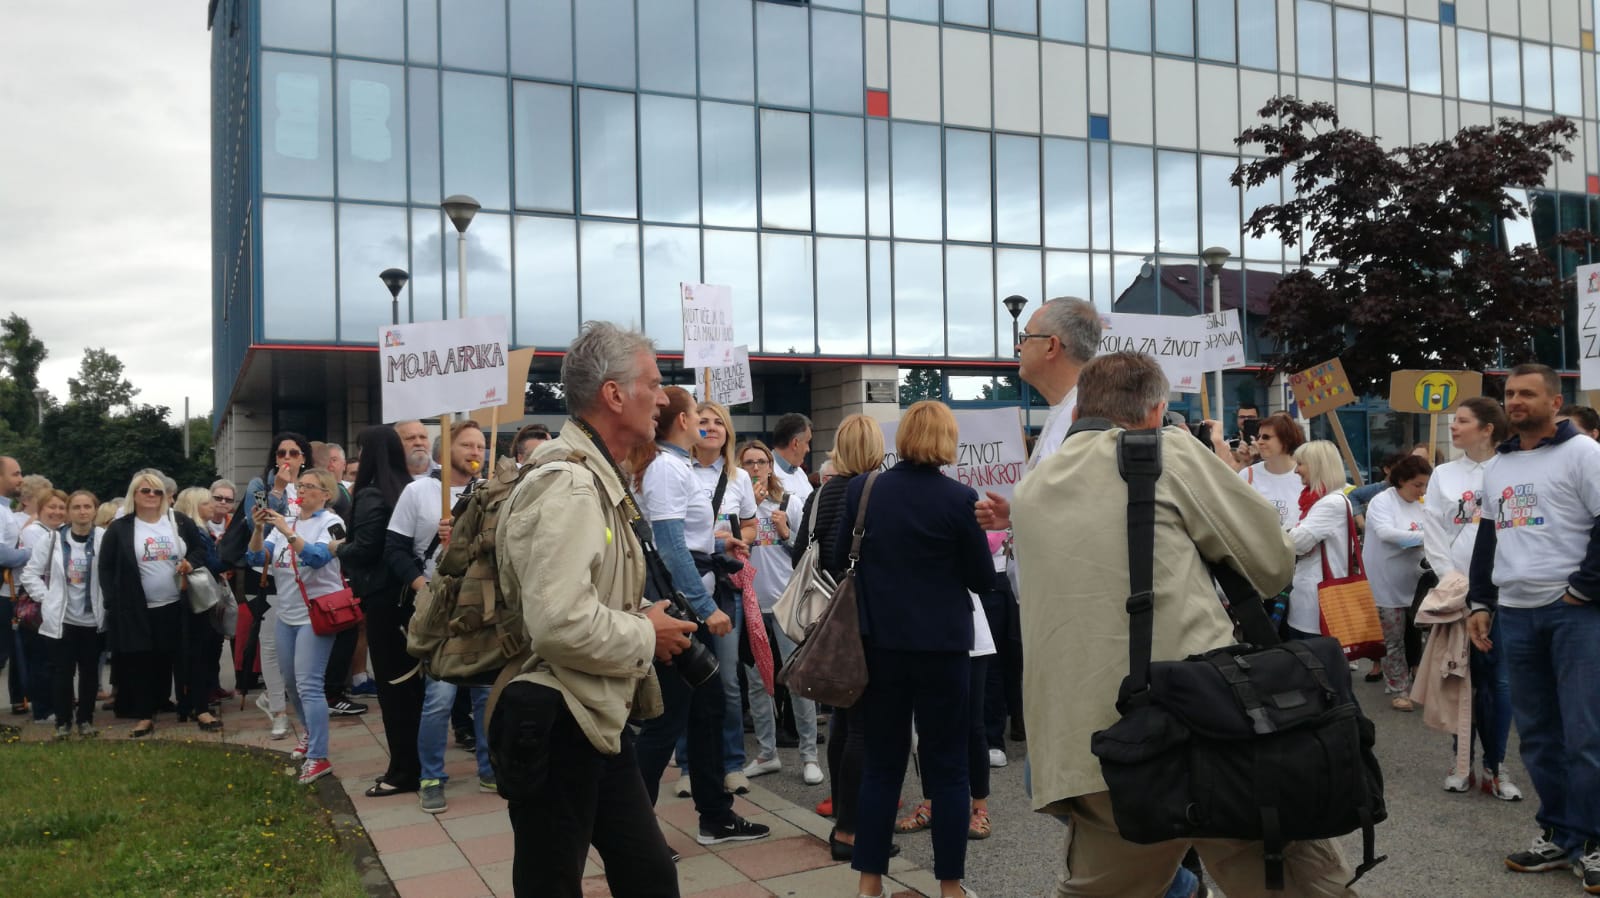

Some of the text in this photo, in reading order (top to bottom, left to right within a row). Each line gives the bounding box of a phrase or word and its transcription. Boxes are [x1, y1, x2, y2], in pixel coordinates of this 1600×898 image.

[1098, 335, 1201, 358] KOLA ZA ŽIVOT
[1584, 334, 1600, 359] Z
[386, 342, 505, 383] MOJA AFRIKA
[956, 441, 1004, 467] ŽIVOT
[957, 462, 1023, 488] BANKROT
